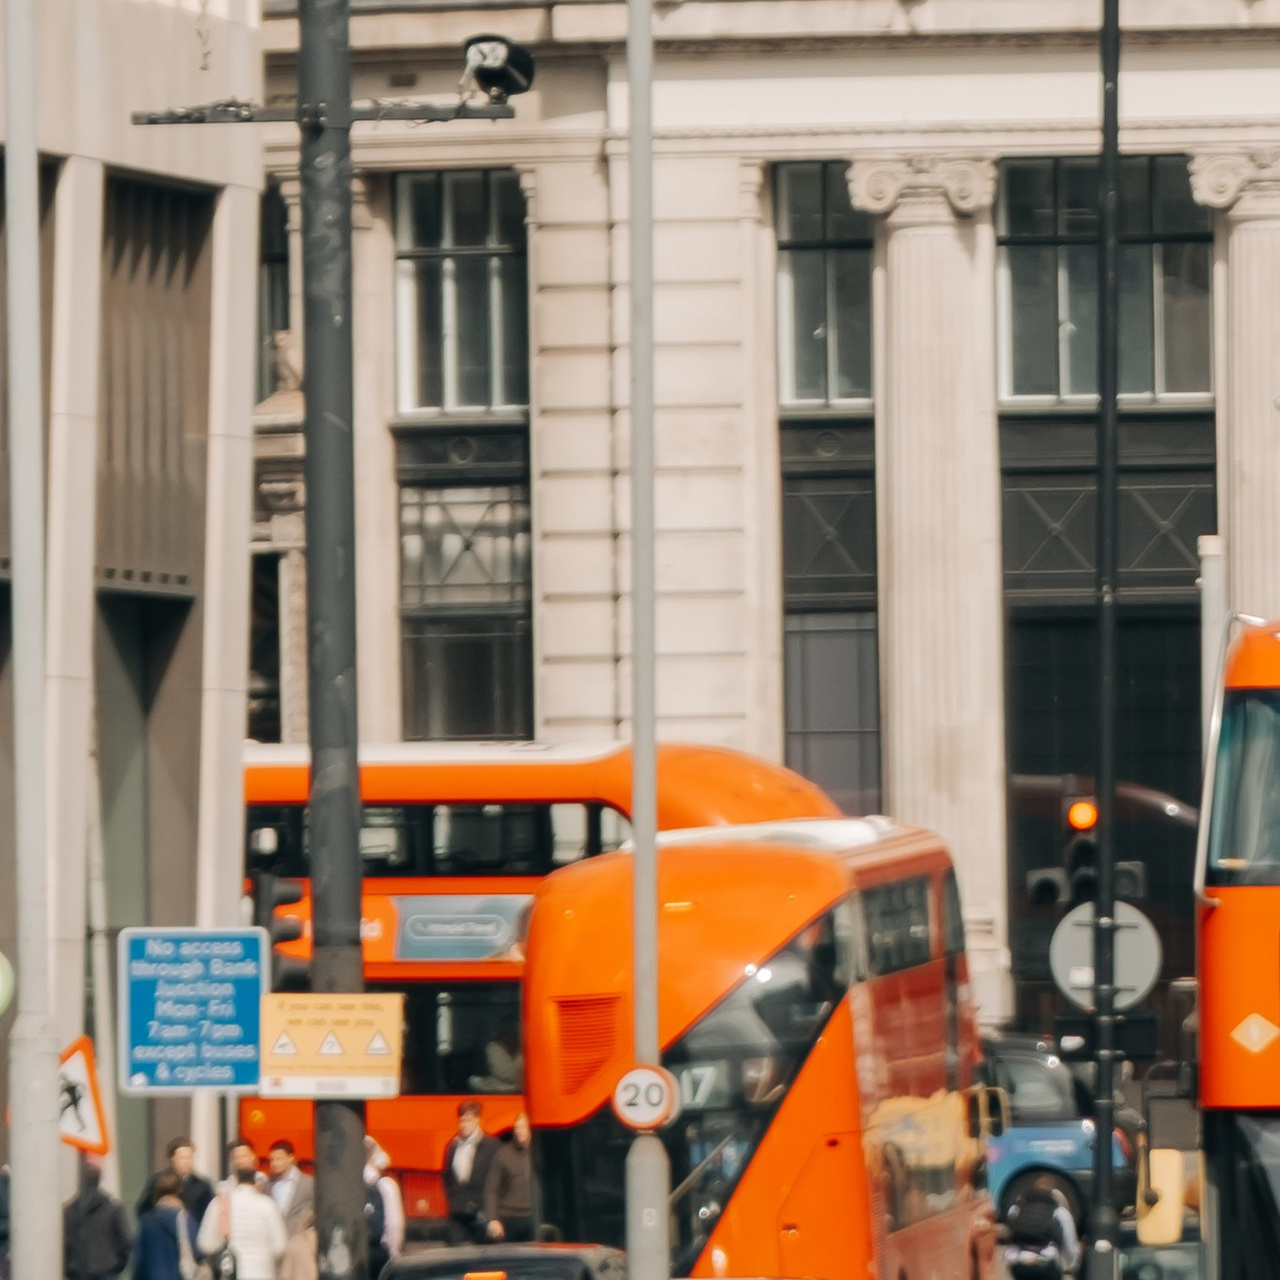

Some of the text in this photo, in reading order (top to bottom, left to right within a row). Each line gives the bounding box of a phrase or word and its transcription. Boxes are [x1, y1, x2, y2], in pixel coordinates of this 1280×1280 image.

[146, 939, 243, 956] No access
[131, 958, 258, 978] through Bank
[154, 980, 235, 998] Junction
[132, 1041, 256, 1061] except buses
[174, 1061, 235, 1082] cycles
[622, 1082, 665, 1108] 20
